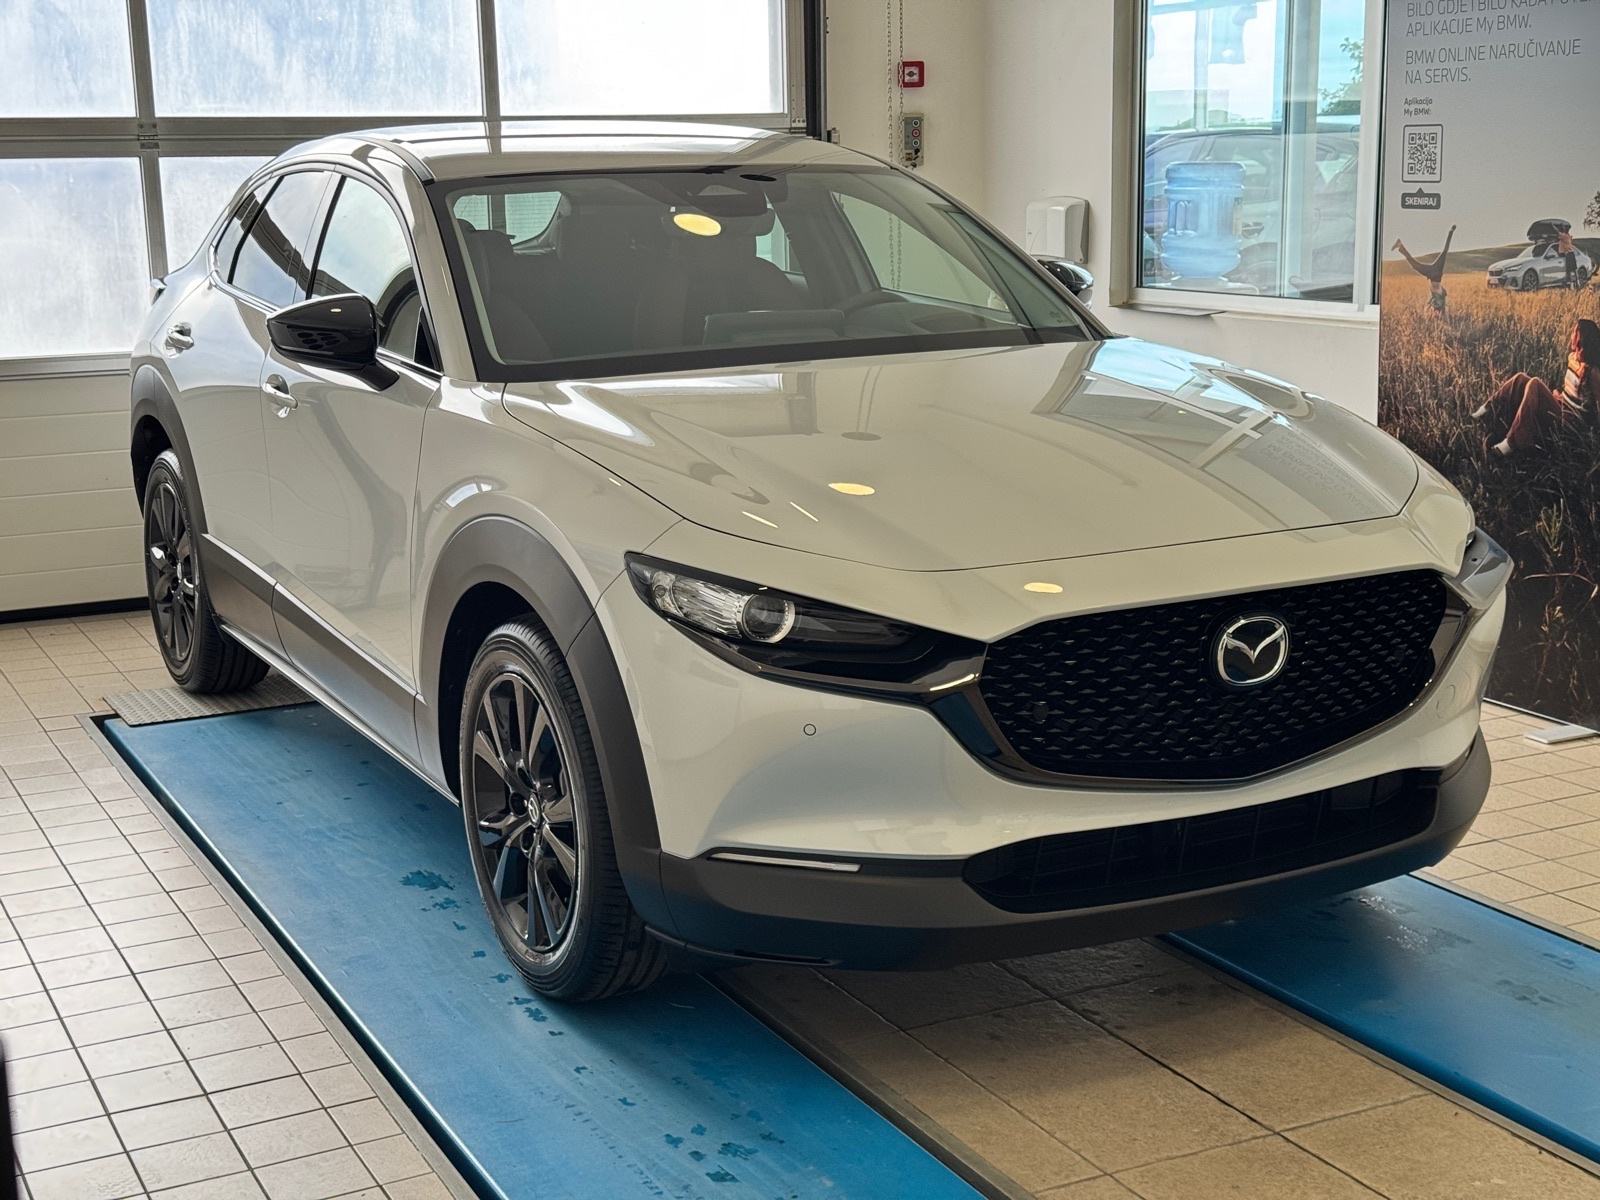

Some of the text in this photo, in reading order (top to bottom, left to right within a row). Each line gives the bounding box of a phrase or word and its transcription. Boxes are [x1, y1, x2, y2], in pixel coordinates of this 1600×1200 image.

[1407, 1, 1434, 17] BILO
[1438, 0, 1468, 15] GDJE
[1406, 13, 1532, 37] APLIKACIJE My BMW.
[1406, 38, 1582, 65] BMW ONLINE NARUČIVANJE
[1405, 66, 1472, 84] NA SERVIS.
[1404, 196, 1437, 206] SKENIRAJ
